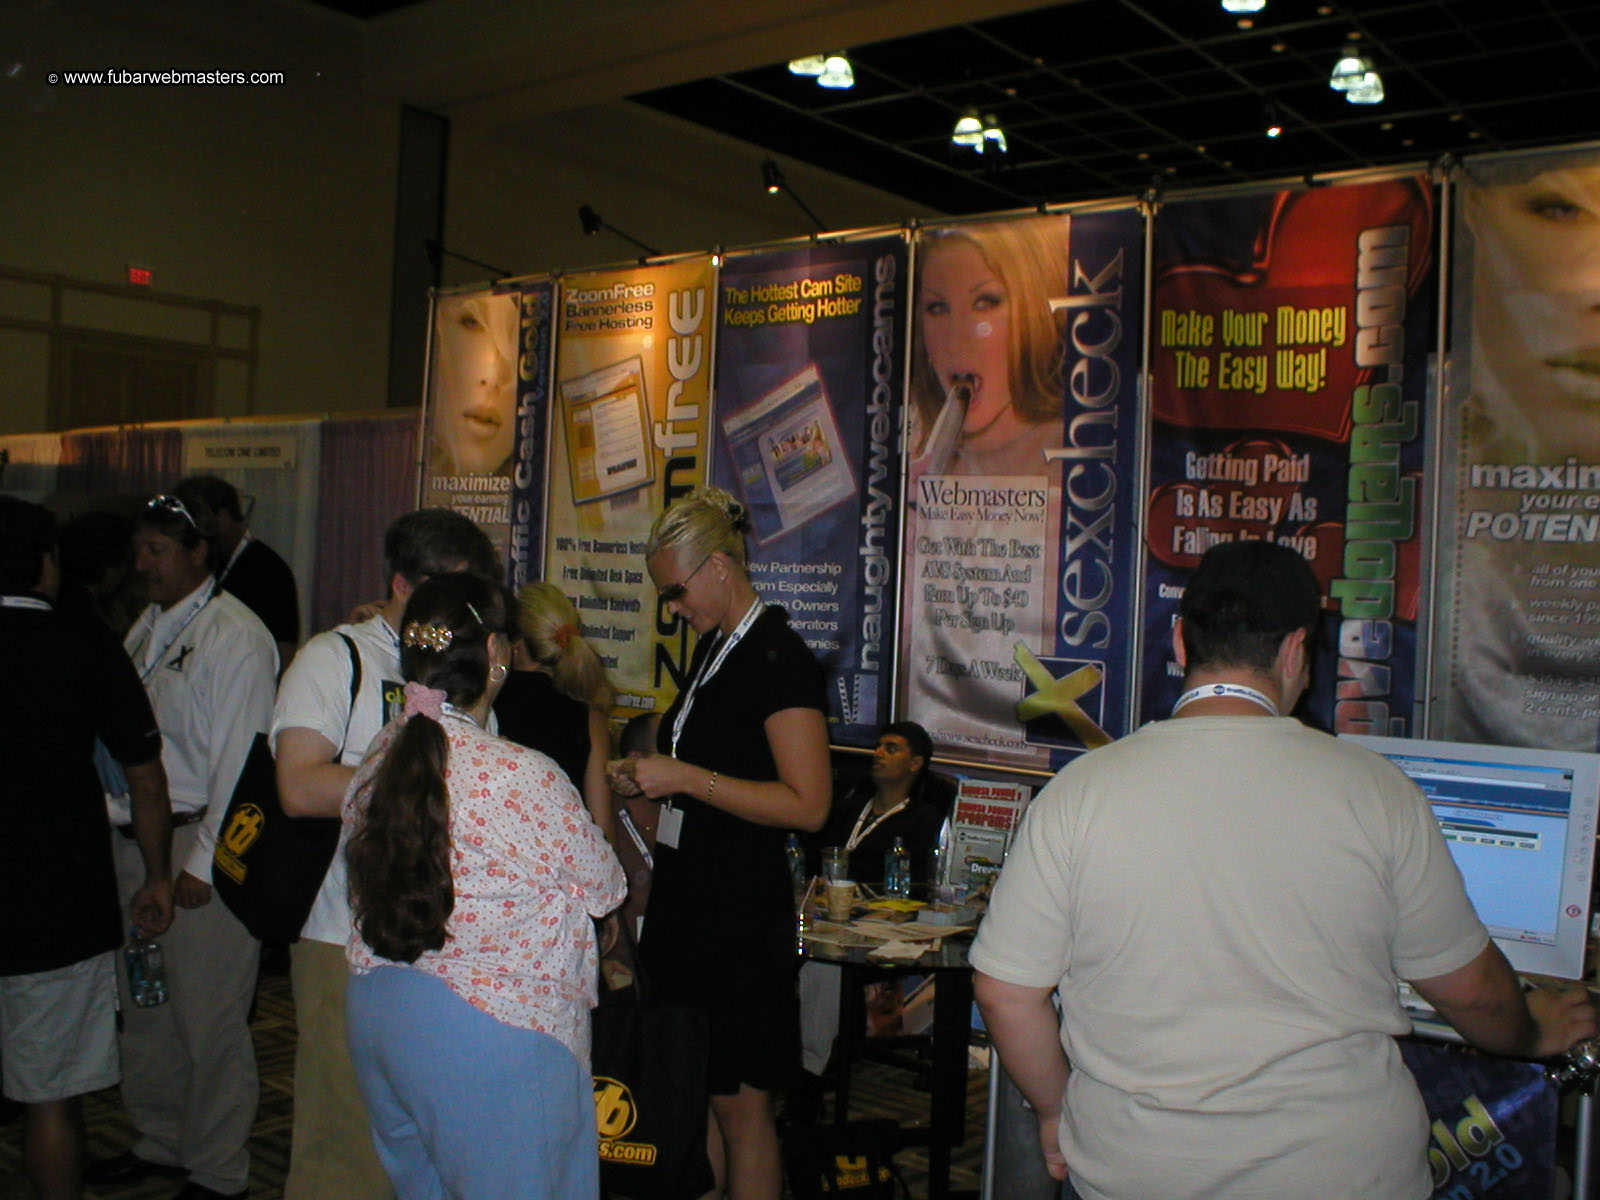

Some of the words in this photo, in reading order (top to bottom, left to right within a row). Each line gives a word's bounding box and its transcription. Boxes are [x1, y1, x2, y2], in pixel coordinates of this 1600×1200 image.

[566, 283, 655, 304] ZoomFree
[725, 287, 748, 304] The
[750, 282, 799, 302] Hottest
[800, 278, 833, 298] Cam
[834, 273, 861, 294] Site
[565, 301, 654, 318] Bannerless
[724, 308, 766, 328] Keeps
[767, 304, 815, 324] Getting
[816, 298, 861, 318] Hotter
[565, 319, 596, 331] Free
[599, 315, 654, 330] Hosting
[1160, 310, 1214, 346] Make
[1222, 309, 1269, 346] Your
[1276, 306, 1347, 346] Money
[519, 295, 542, 381] Gold
[1175, 351, 1210, 388] The
[1217, 352, 1268, 394] Easy
[1276, 348, 1327, 393] Way!
[514, 392, 541, 489] Cash
[1043, 247, 1125, 649] sexcheck
[859, 253, 897, 671] naughtywebcams
[1185, 451, 1259, 486] Getting
[1264, 453, 1310, 483] Paid
[432, 472, 511, 491] maximize
[919, 480, 1046, 508] Webmasters
[1176, 488, 1193, 517] Is
[1198, 490, 1223, 518] As
[1228, 492, 1283, 526] Easy
[1288, 496, 1318, 522] As
[1520, 494, 1579, 511] your
[918, 507, 948, 520] Make
[950, 508, 974, 525] Easy
[977, 508, 1013, 525] Money
[1014, 509, 1045, 523] Now!
[563, 565, 578, 580] Free
[624, 568, 643, 585] Space
[770, 562, 842, 576] Partnership
[778, 580, 839, 596] Especially
[1530, 576, 1565, 588] from
[791, 599, 840, 613] Owners
[956, 584, 979, 609] Up
[990, 611, 1016, 635] Up
[1469, 1143, 1524, 1190] 2.0
